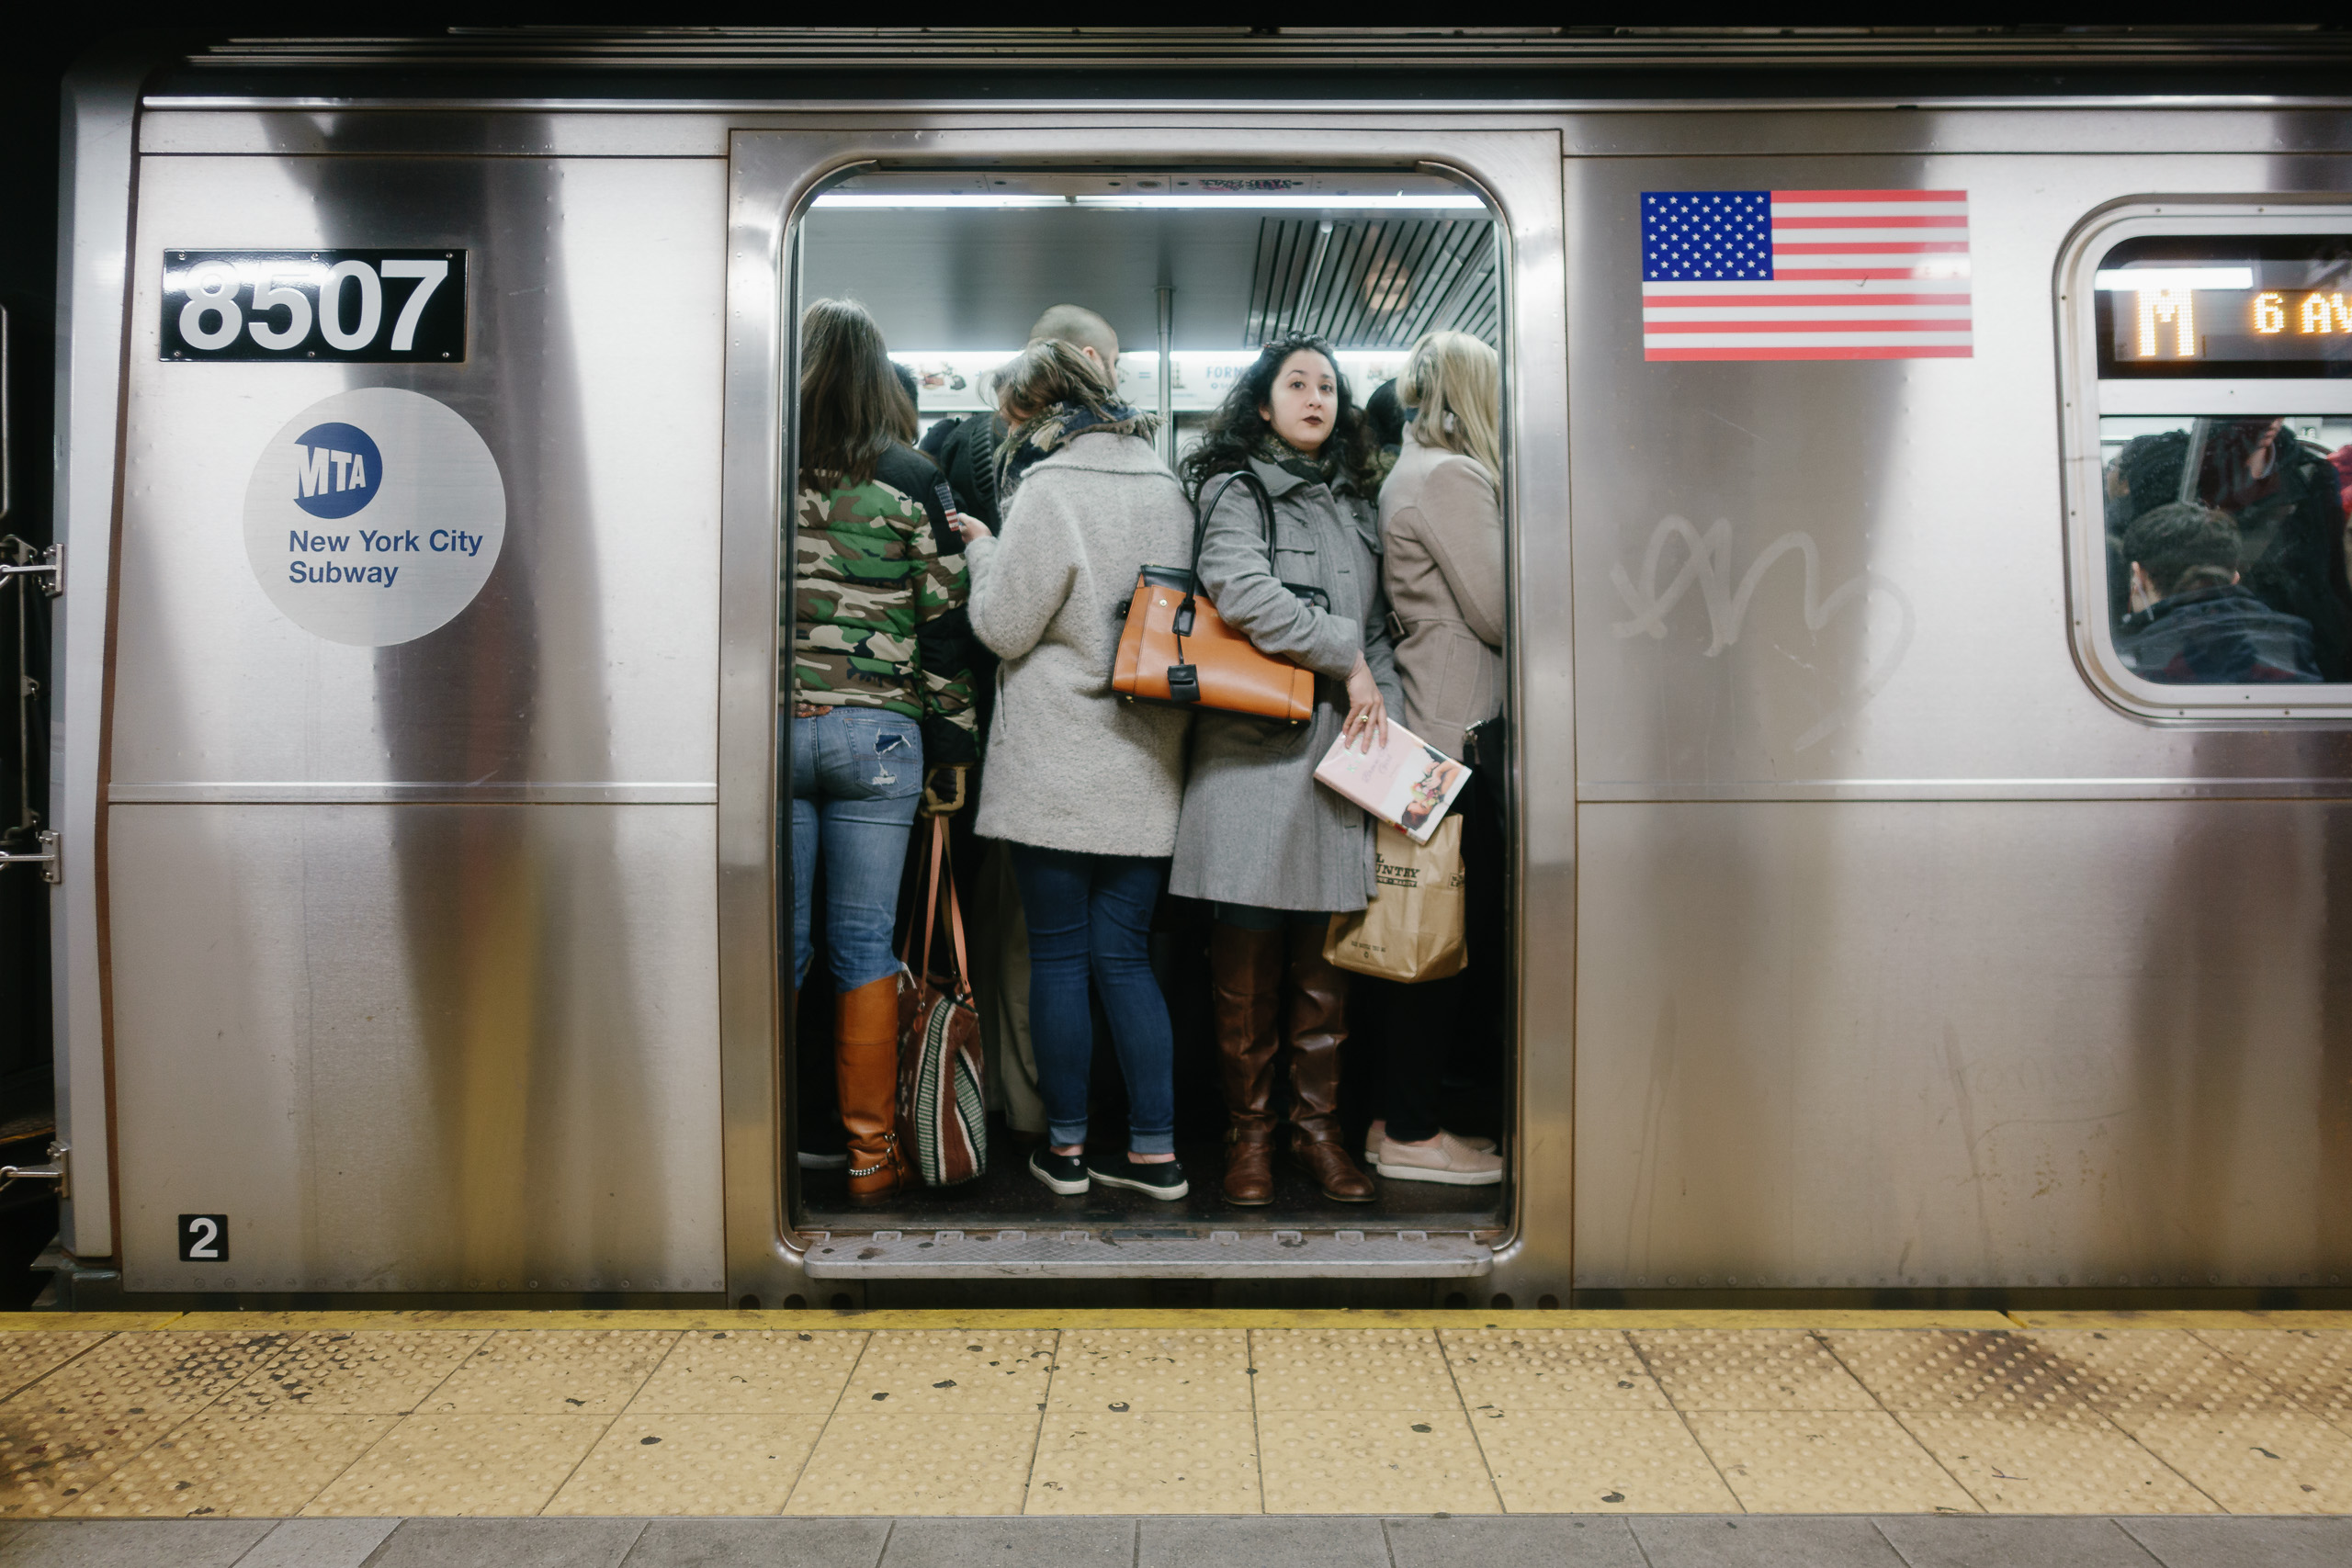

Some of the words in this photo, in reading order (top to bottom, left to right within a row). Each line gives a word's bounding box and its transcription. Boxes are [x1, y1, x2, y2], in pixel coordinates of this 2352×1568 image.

[179, 260, 448, 351] 8507
[2137, 288, 2195, 357] M
[2254, 291, 2285, 333] 6
[293, 444, 367, 499] MTA
[288, 529, 349, 552] New
[358, 529, 420, 552] York
[429, 529, 483, 557] City
[288, 560, 399, 588] Subway
[189, 1217, 219, 1258] 2
